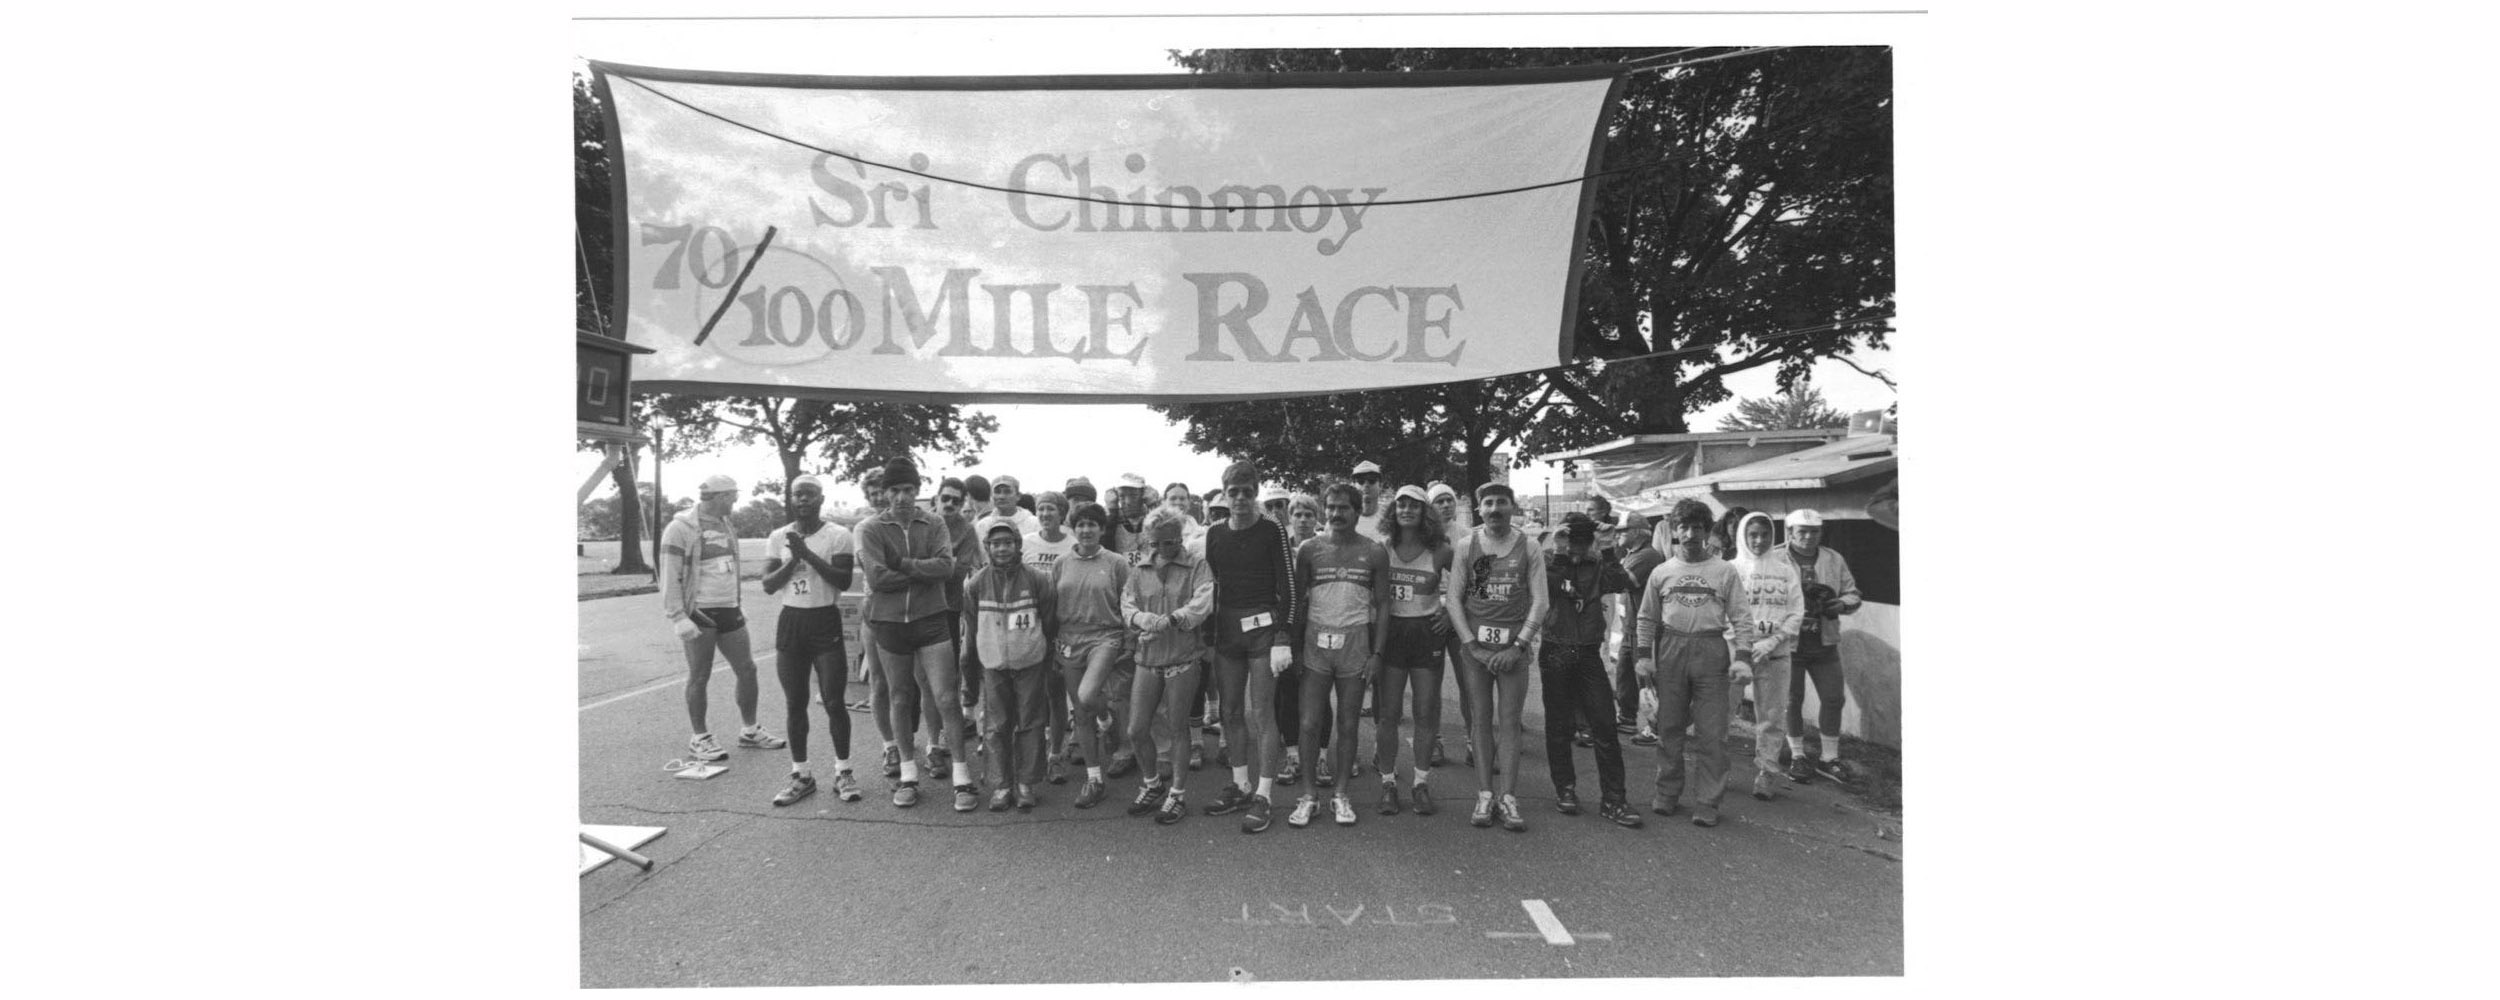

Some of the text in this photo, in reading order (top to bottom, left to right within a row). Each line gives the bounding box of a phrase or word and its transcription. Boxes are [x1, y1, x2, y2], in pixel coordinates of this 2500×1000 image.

[808, 149, 1387, 257] Sri Chinmoy
[870, 265, 1149, 365] MILE
[1184, 270, 1466, 367] RACE
[792, 579, 808, 595] 32
[1015, 614, 1030, 628] 44
[1758, 620, 1774, 635] 47
[1485, 627, 1501, 644] 38
[1222, 902, 1458, 927] START
